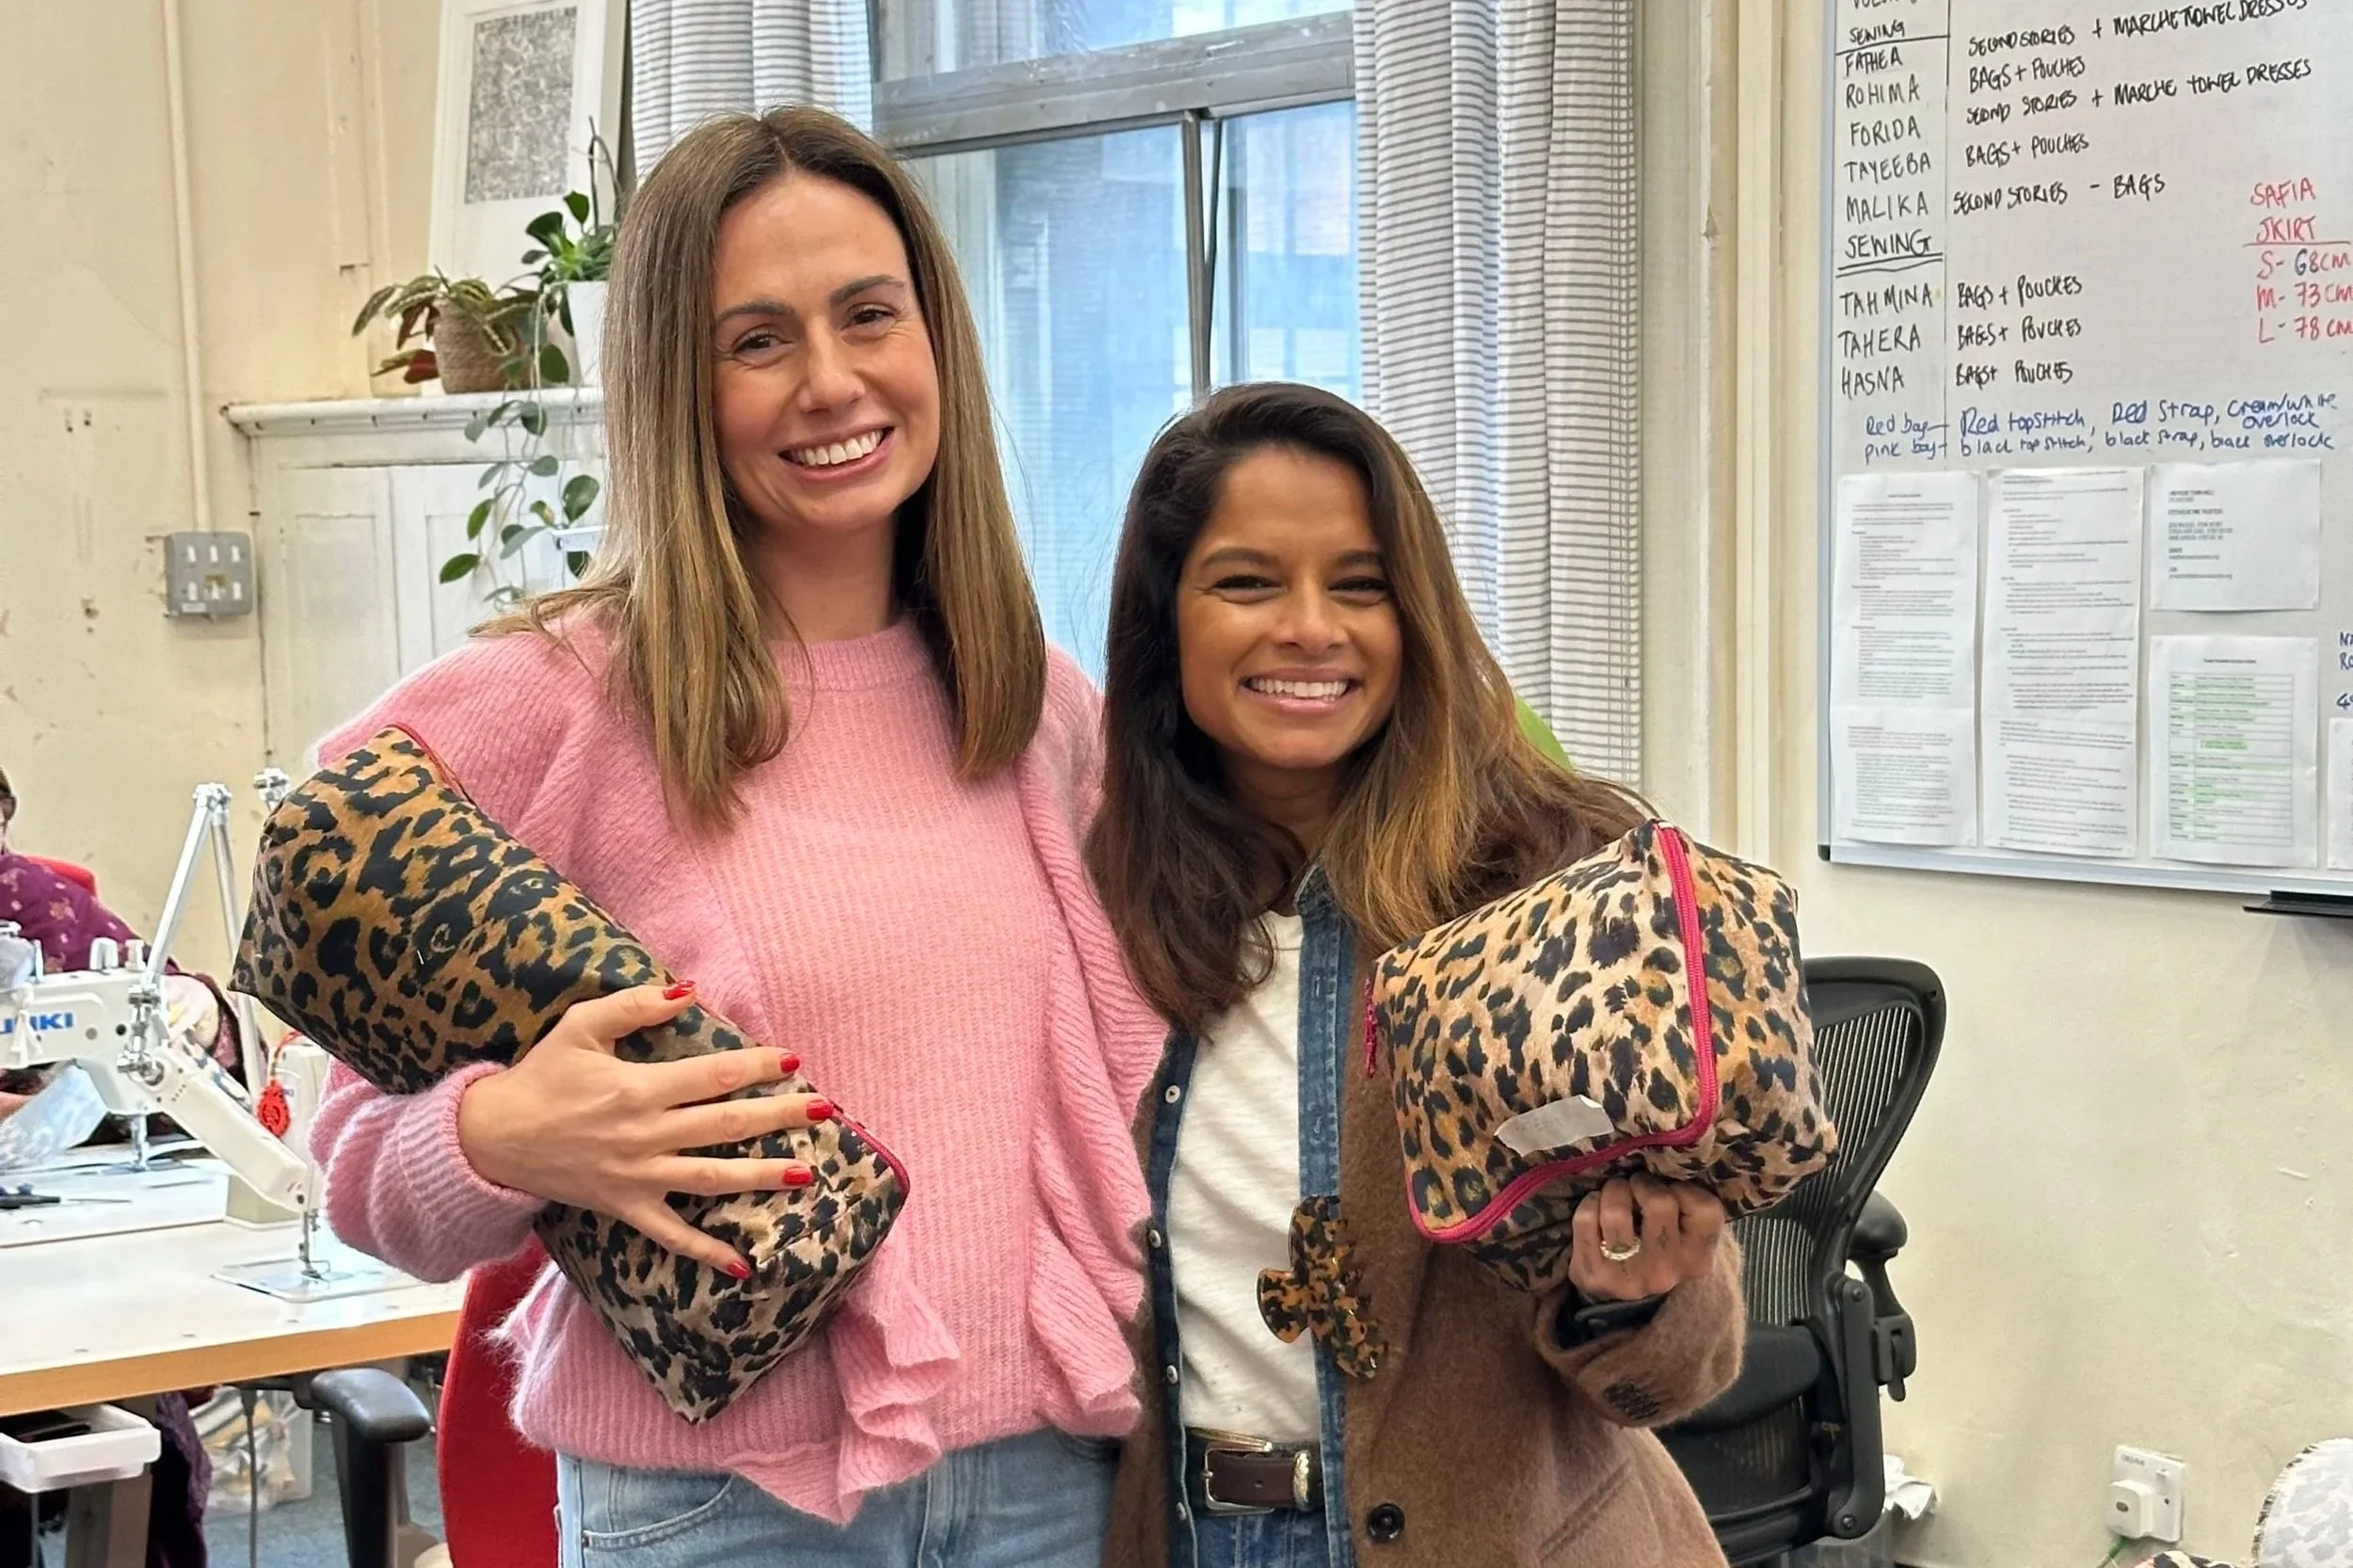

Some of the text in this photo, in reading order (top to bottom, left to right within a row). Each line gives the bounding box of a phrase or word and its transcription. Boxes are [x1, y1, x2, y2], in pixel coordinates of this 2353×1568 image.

[2032, 56, 2086, 80] POUCHES
[1846, 73, 1920, 108] ROHIMA
[2023, 89, 2078, 116] STORIES
[2115, 79, 2177, 105] MARCHE
[2247, 58, 2312, 85] DRESSES
[1850, 116, 1921, 148] FORIDA
[2031, 133, 2089, 158] POUCHES
[1844, 152, 1931, 184] TAYEEBA
[2113, 173, 2166, 201] BAGS
[2249, 177, 2316, 208] SAFIA
[1846, 191, 1929, 224] MALIKA
[1845, 229, 1931, 259] SEWING
[1839, 282, 1932, 318] TAHMINA
[1837, 324, 1921, 359] TAHERA
[1841, 365, 1905, 400] HASNA
[1866, 412, 1896, 437] Red
[1961, 407, 1999, 438] Red
[1865, 440, 1902, 465] pink
